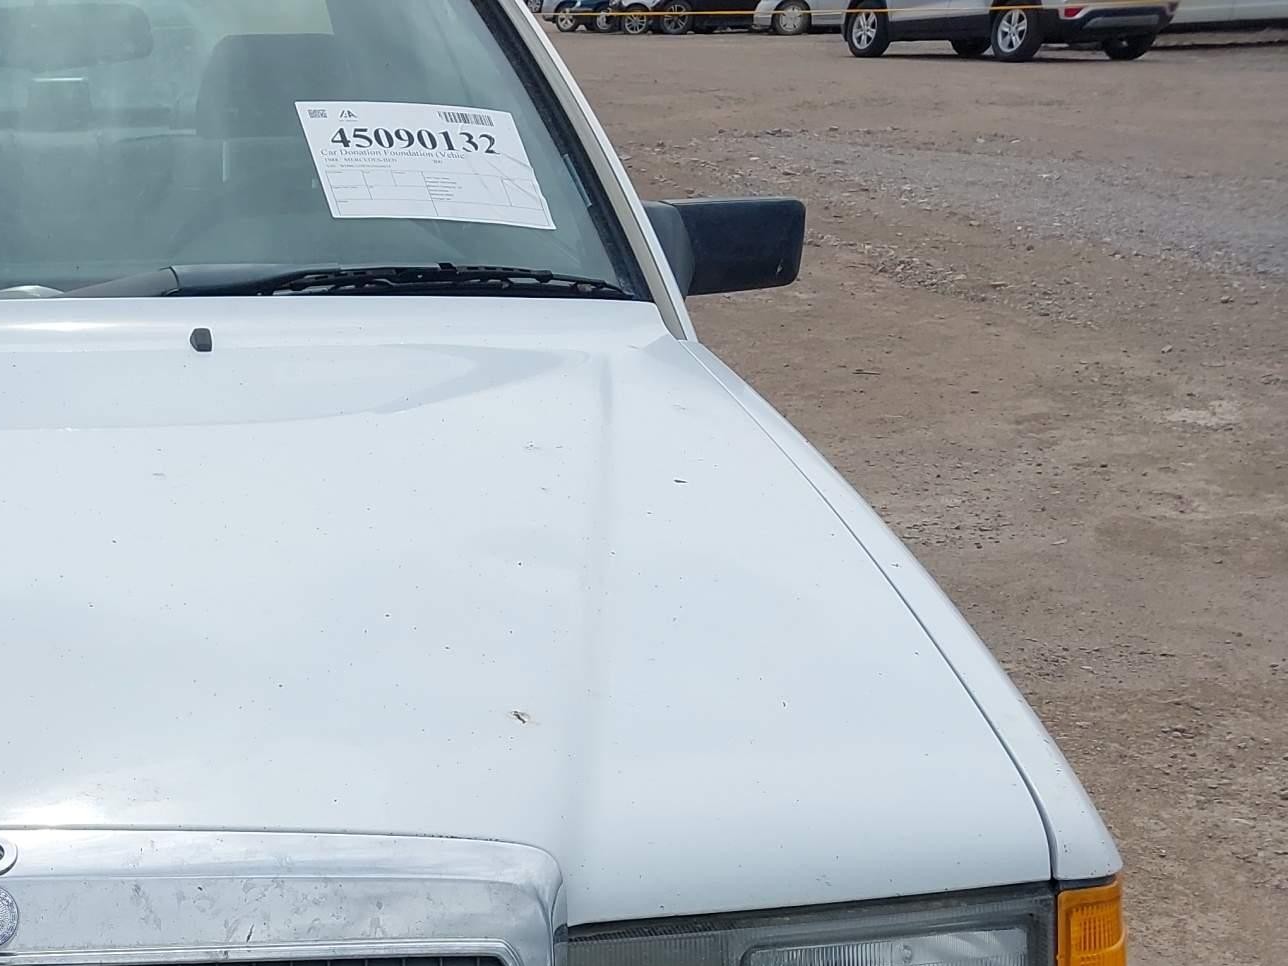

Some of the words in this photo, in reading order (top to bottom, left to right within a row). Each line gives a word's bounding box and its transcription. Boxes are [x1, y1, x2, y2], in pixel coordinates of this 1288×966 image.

[331, 127, 501, 155] 45090132
[340, 149, 381, 157] Donation
[383, 149, 434, 159] Foundation
